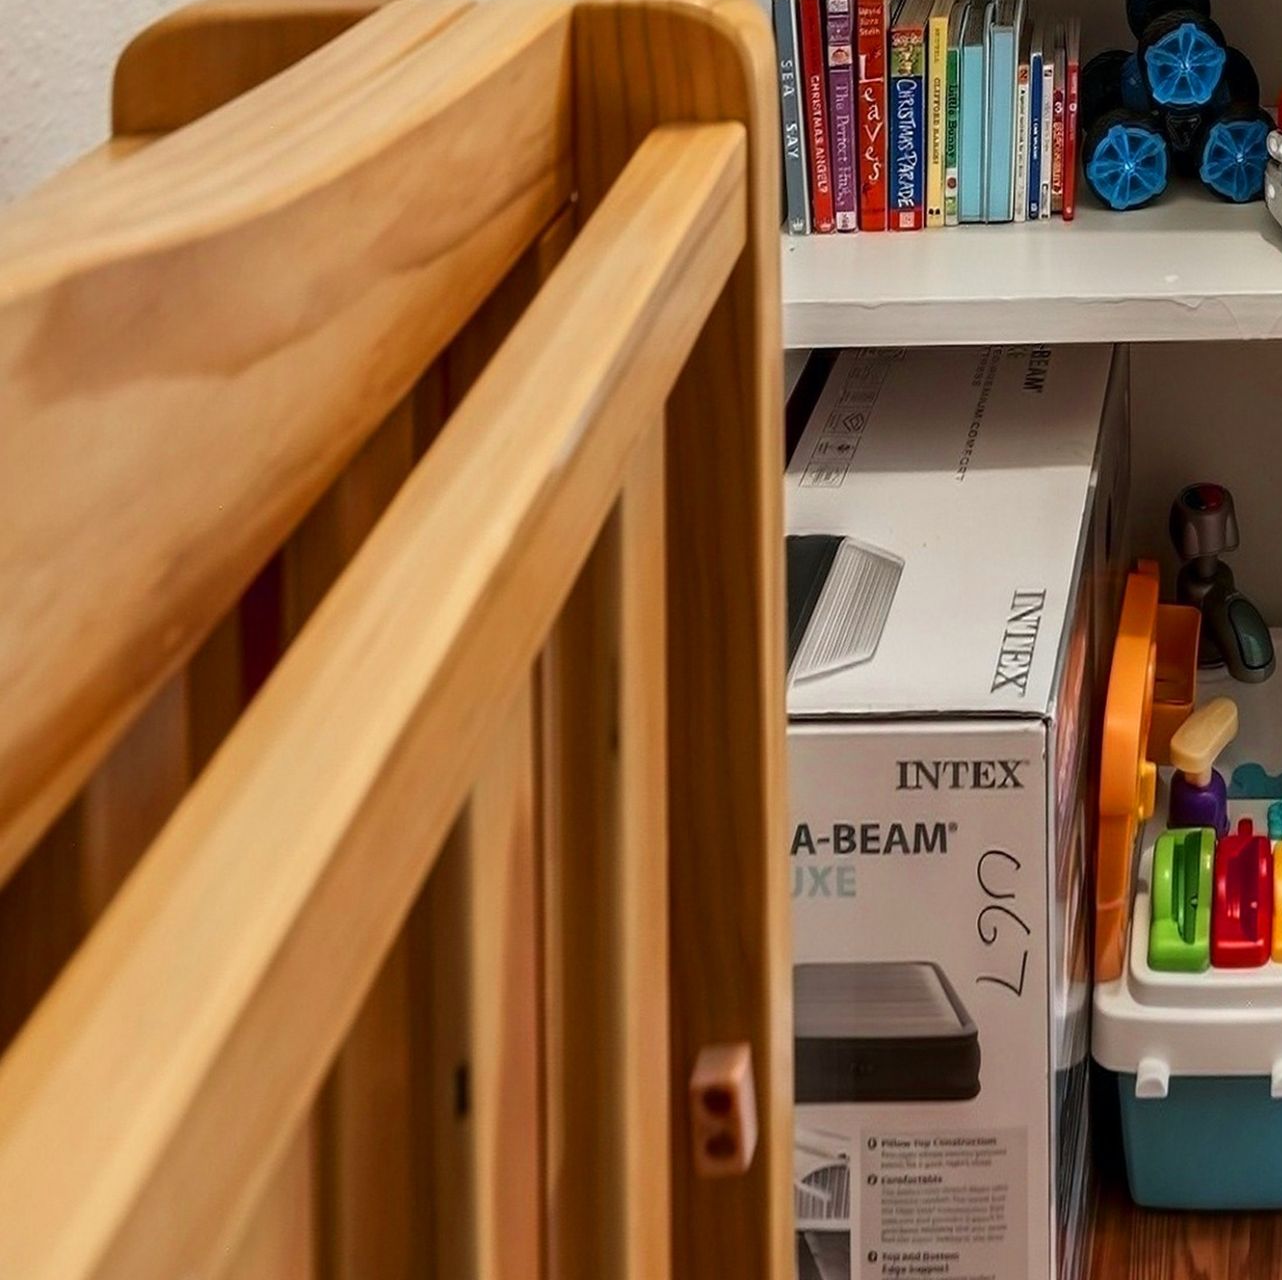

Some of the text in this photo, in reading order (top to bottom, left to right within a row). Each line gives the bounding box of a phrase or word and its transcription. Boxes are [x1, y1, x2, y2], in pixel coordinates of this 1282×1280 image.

[781, 59, 799, 159] SEA SAY
[810, 75, 824, 143] CHRISTMAS
[835, 84, 849, 110] The
[859, 53, 883, 181] Leaves
[932, 77, 941, 125] CLIFFORD
[946, 84, 958, 158] Little Bunny
[836, 114, 850, 161] Perfect
[896, 79, 917, 208] CHRISTMAS PARADE
[1022, 342, 1051, 394] -BEAM
[990, 587, 1047, 698] INTEX
[895, 758, 1026, 792] INTEX
[791, 865, 857, 898] UXE
